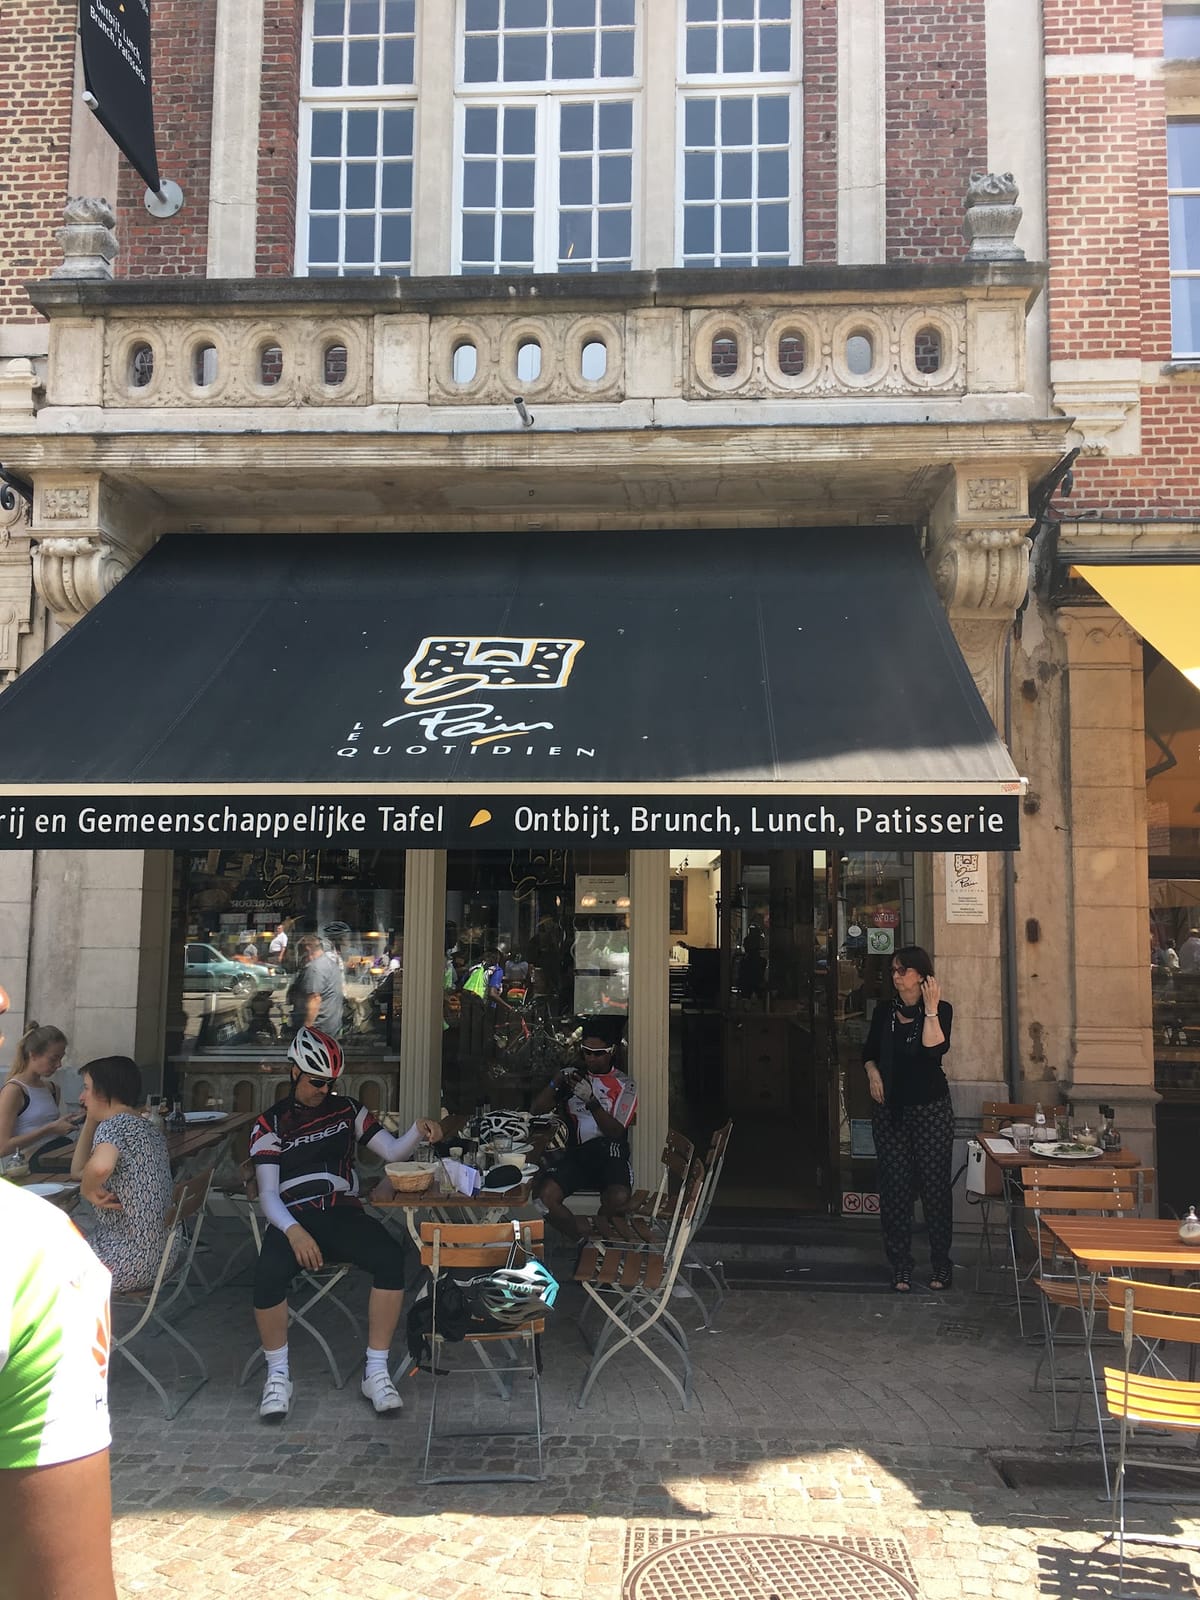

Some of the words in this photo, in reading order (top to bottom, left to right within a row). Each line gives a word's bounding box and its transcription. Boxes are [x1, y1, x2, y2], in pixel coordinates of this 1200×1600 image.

[90, 5, 117, 47] Brunch,
[118, 38, 146, 85] Patisserie
[123, 28, 142, 65] Lunch,
[383, 703, 553, 741] Pain
[336, 745, 595, 758] QUOTIDIEN
[35, 814, 66, 833] en
[78, 805, 366, 840] Gemeenschappelijke
[377, 805, 443, 832] Tafel
[514, 805, 620, 839] Ontbijt,
[631, 805, 741, 836] Brunch,
[751, 805, 845, 837] Lunch,
[856, 806, 1004, 834] Patisserie
